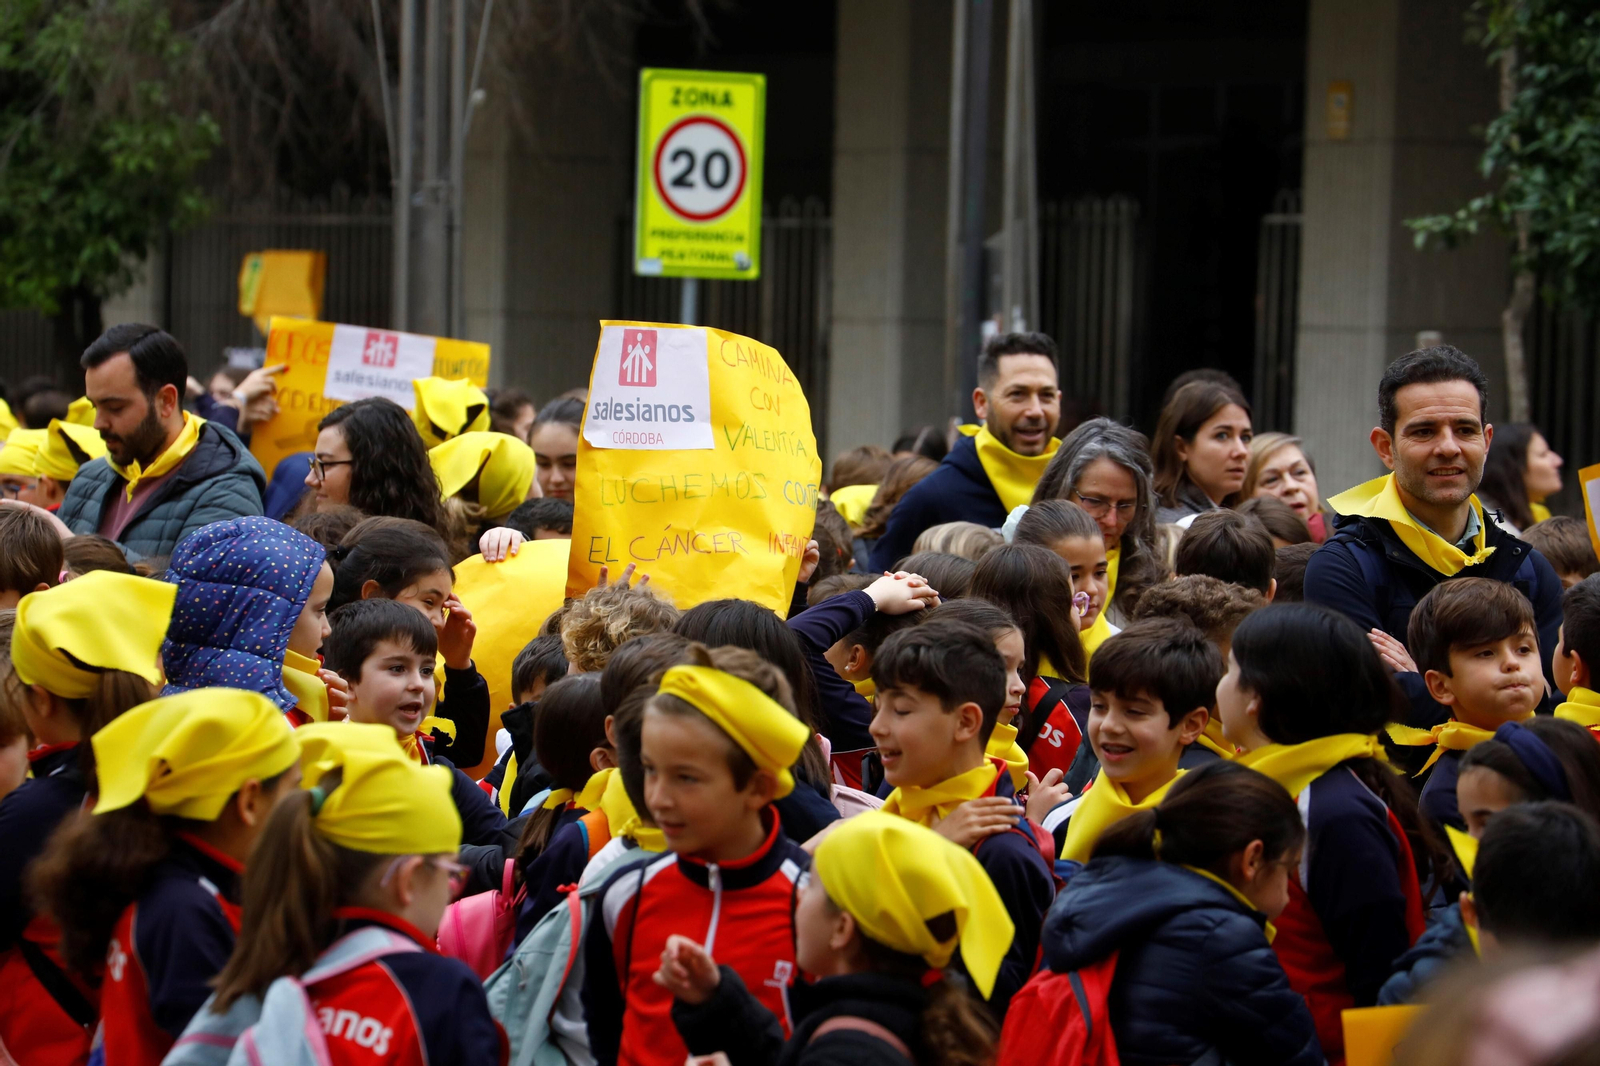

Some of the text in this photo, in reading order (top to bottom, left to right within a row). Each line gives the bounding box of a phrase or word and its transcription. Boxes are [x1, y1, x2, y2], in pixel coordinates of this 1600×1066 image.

[670, 87, 734, 107] ZONA
[669, 148, 731, 190] 20
[720, 339, 796, 389] CAMINA
[592, 397, 695, 423] salesianos
[750, 386, 781, 417] CON
[612, 429, 664, 445] CÓRDOBA
[600, 471, 768, 507] LUCHEMOS
[588, 536, 619, 564] EL
[629, 524, 749, 562] CÁNCER
